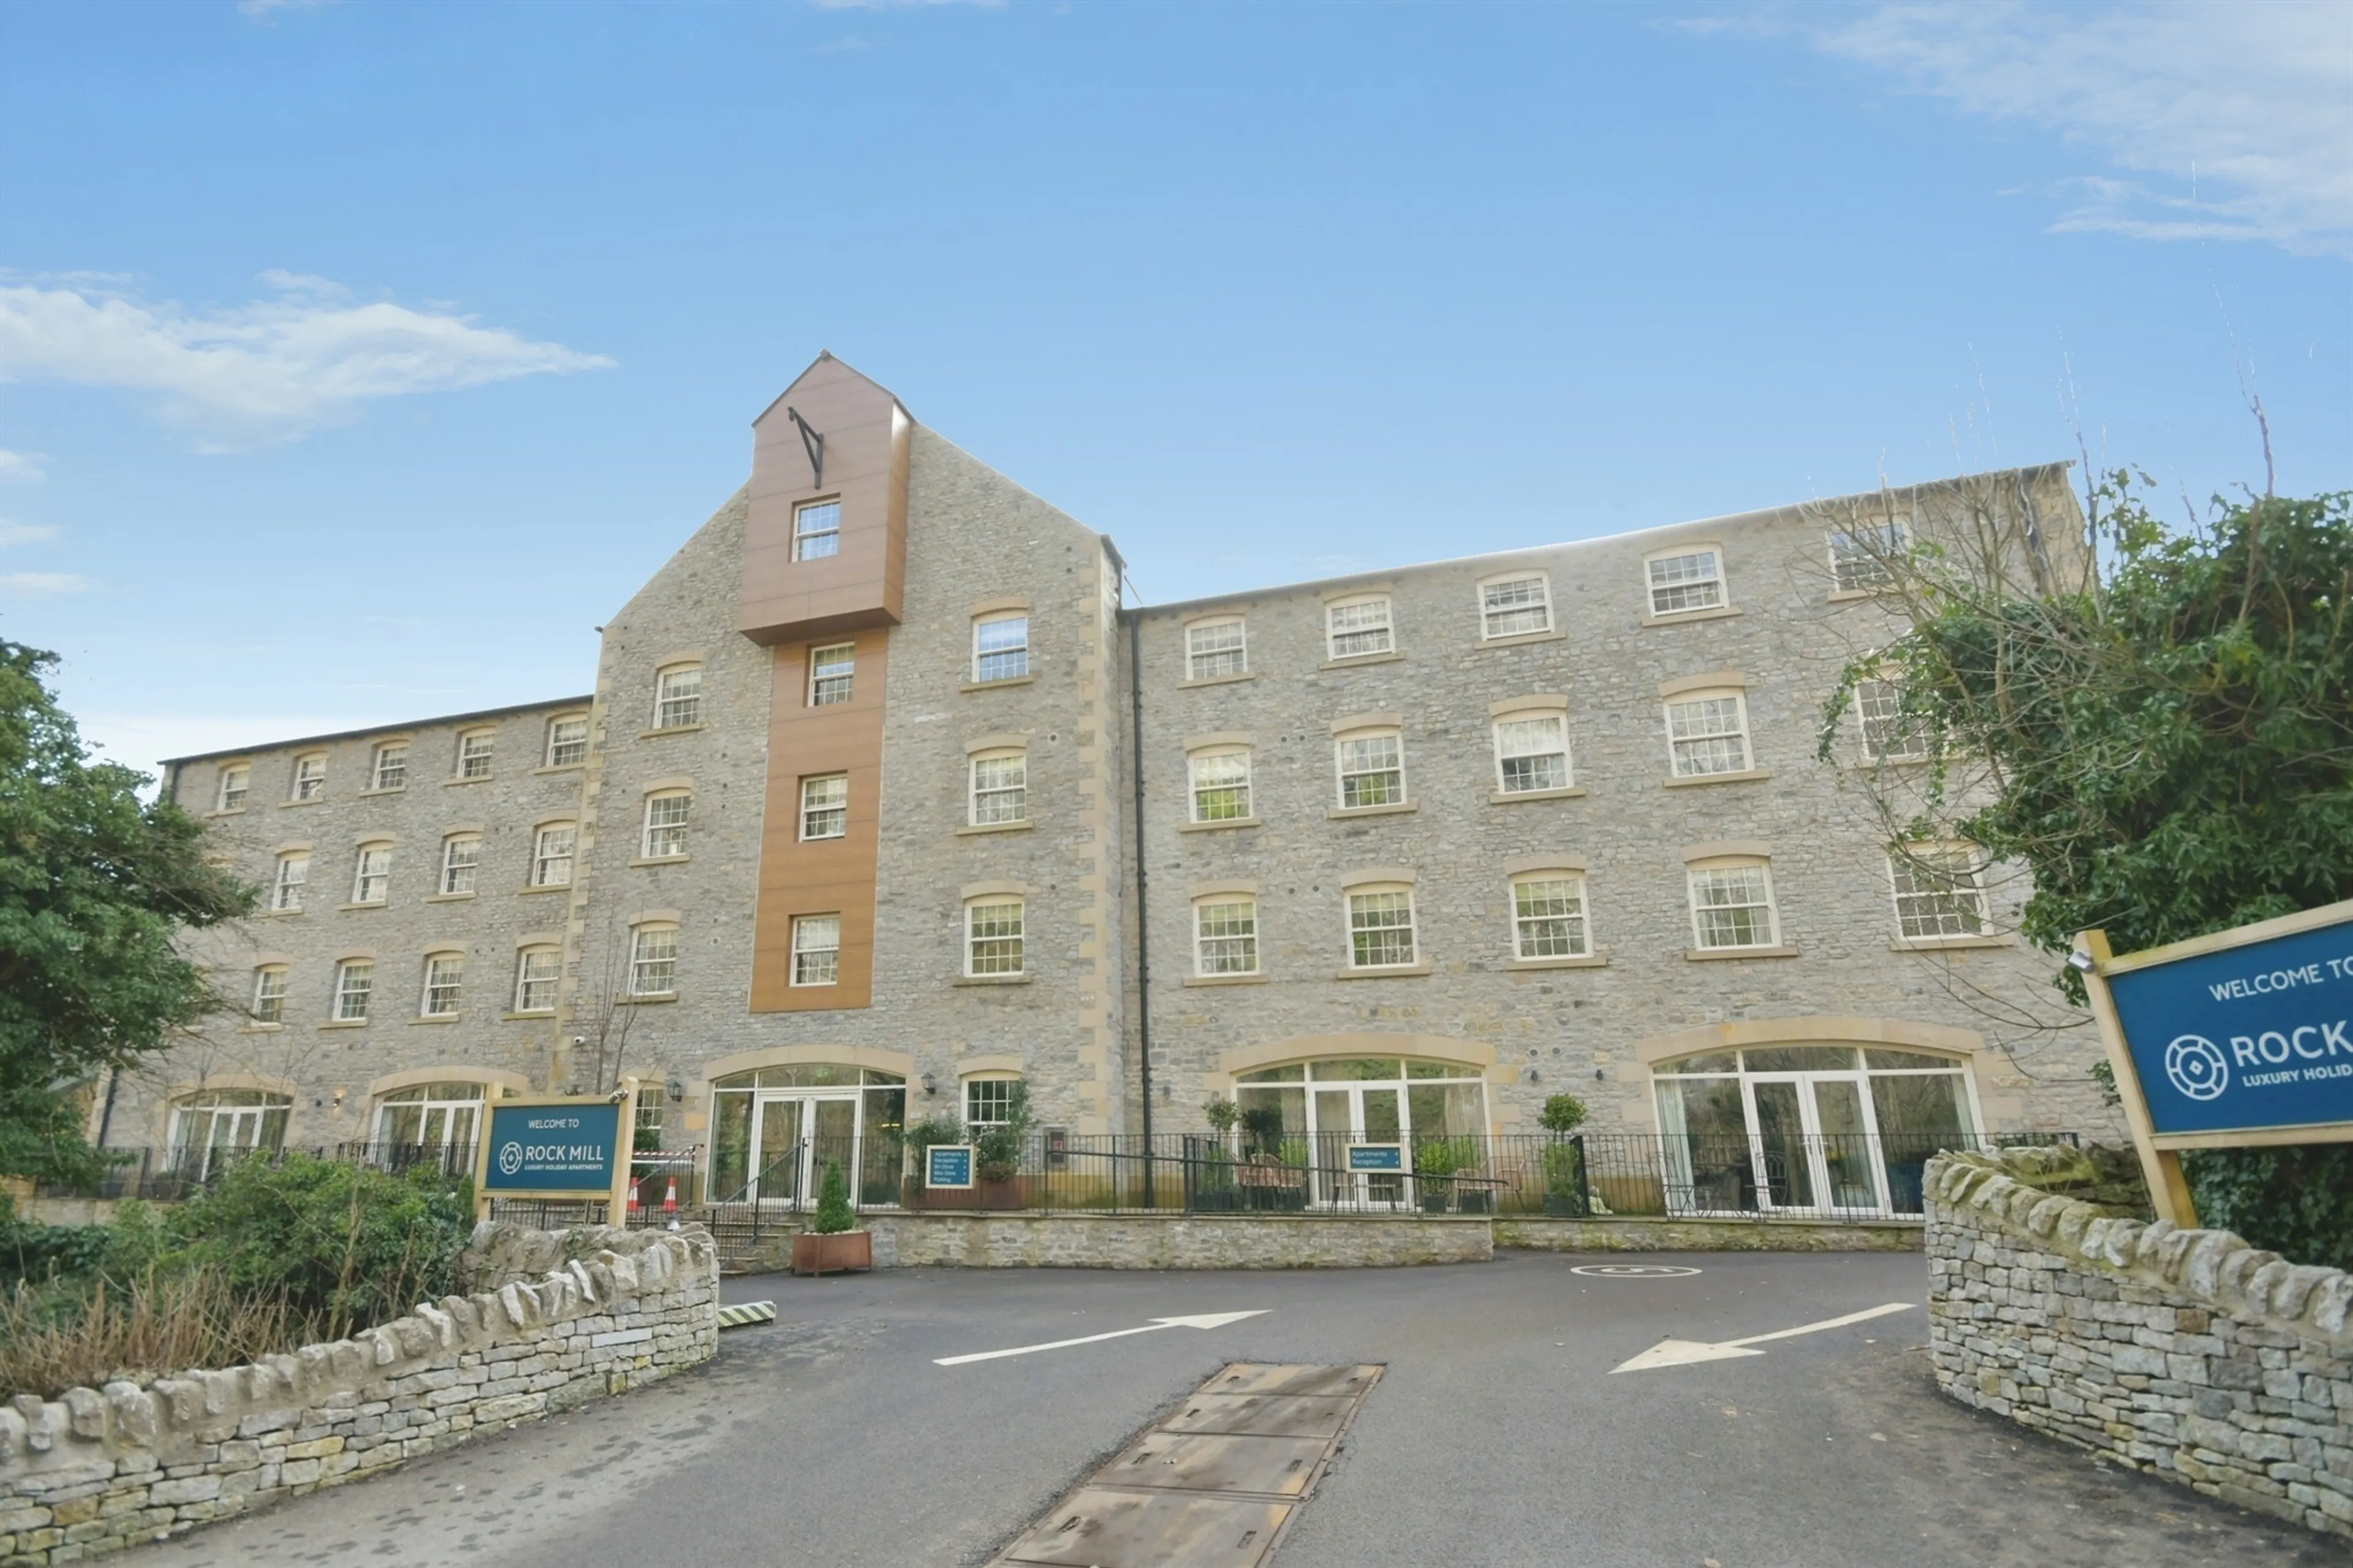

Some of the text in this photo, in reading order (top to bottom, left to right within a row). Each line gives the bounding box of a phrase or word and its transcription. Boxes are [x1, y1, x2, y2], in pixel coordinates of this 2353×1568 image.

[2208, 963, 2324, 1001] WELCOME
[2229, 1020, 2353, 1067] ROCK
[2242, 1064, 2353, 1087] LUXURY HOLID
[528, 1119, 580, 1129] WELCOME TO
[525, 1145, 604, 1161] ROCK MILL
